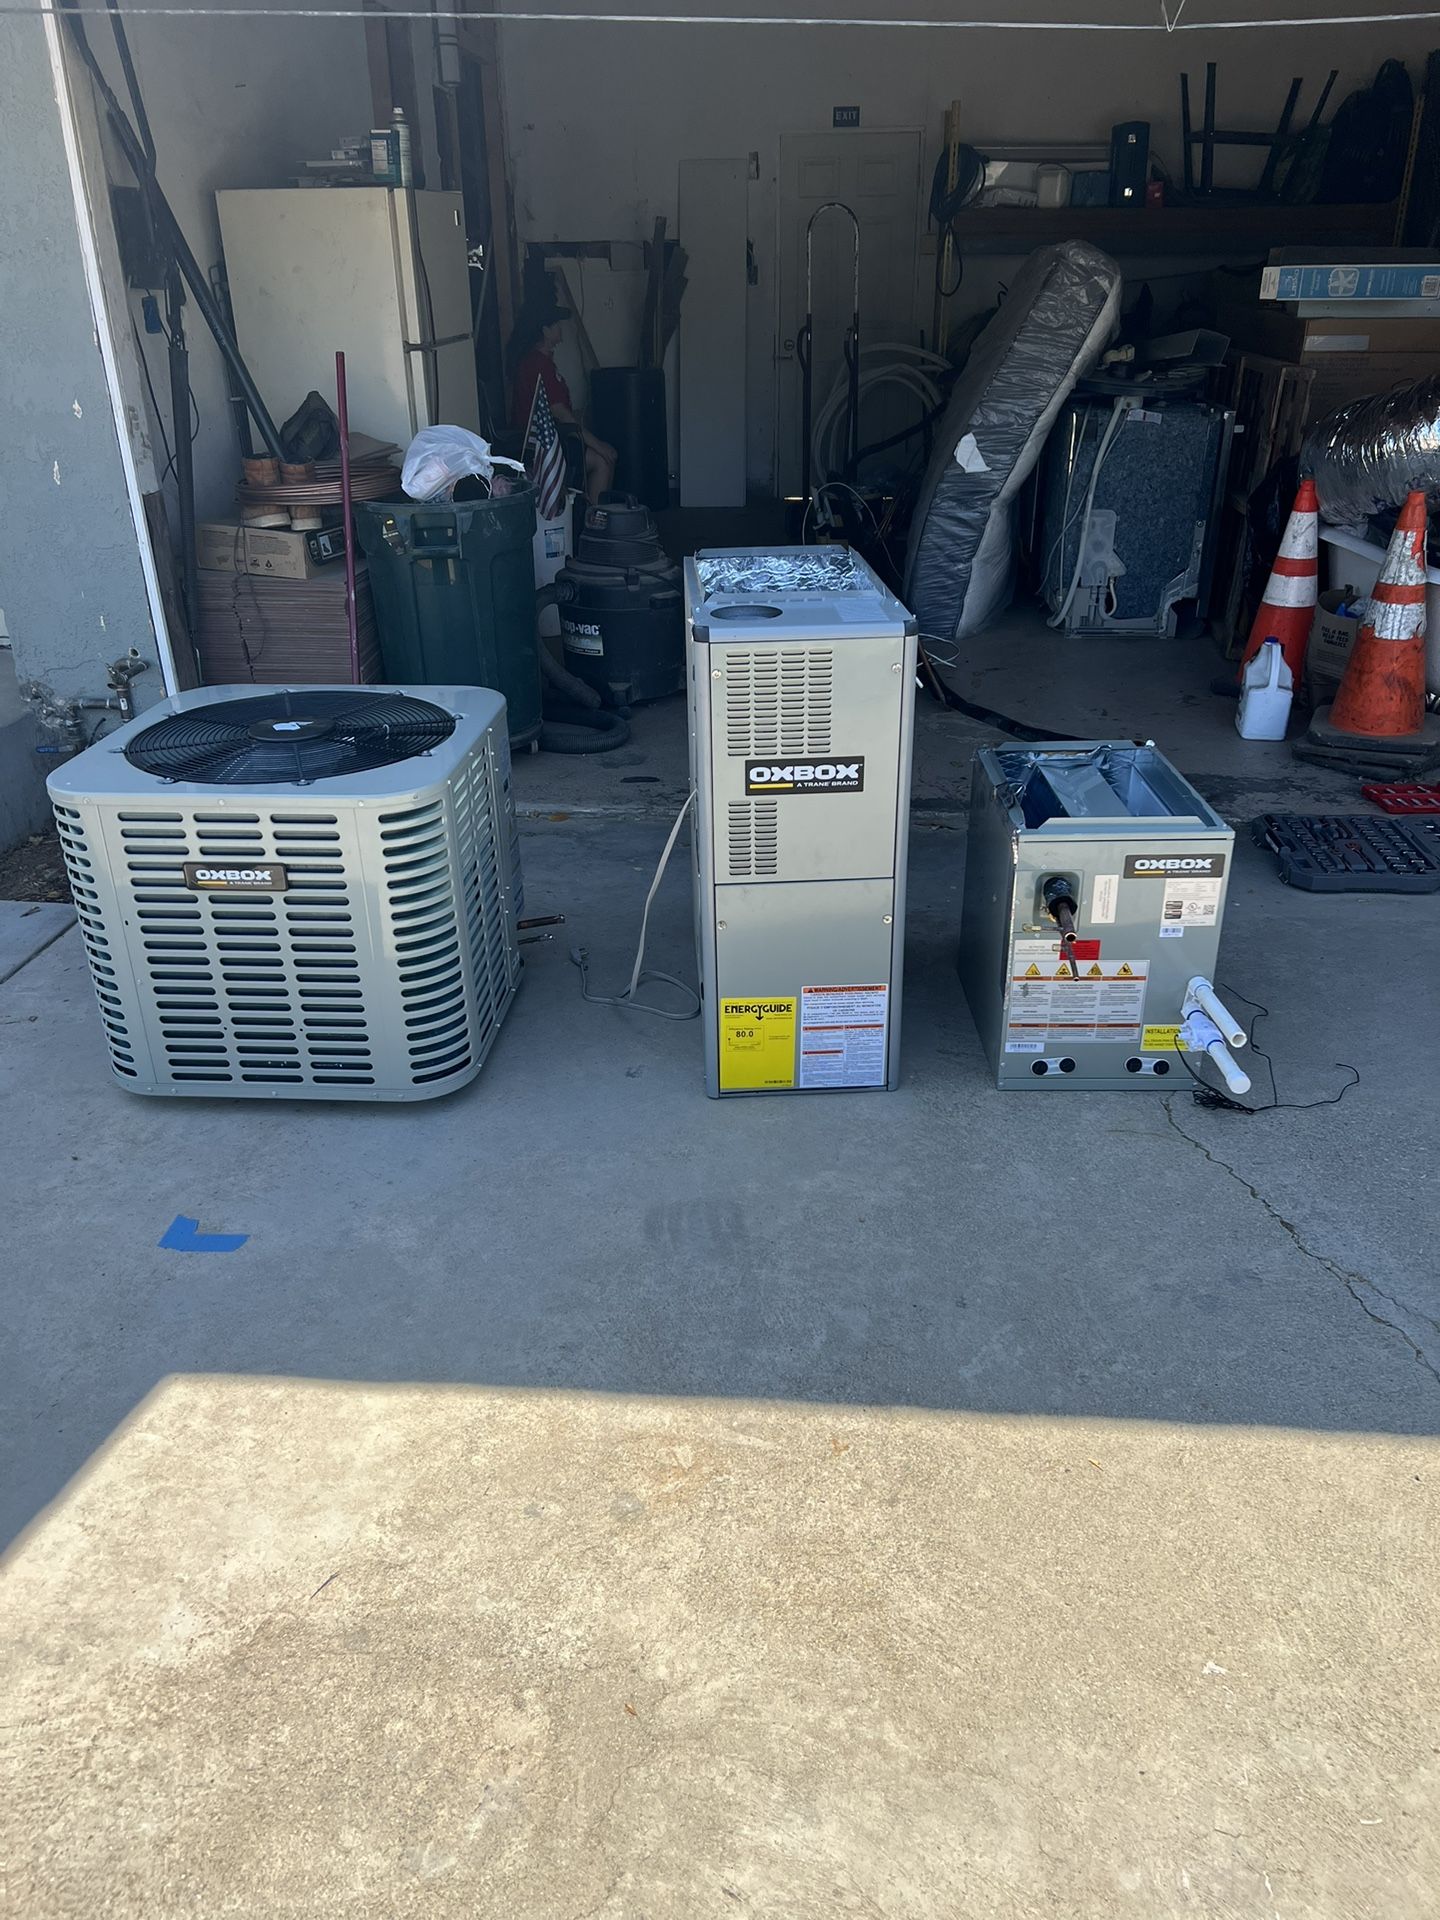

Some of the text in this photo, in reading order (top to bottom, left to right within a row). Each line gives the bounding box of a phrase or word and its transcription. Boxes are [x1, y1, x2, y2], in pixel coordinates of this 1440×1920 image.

[836, 111, 857, 120] EXIT
[749, 764, 860, 782] OXBOX
[1134, 858, 1213, 870] OXBOX
[195, 869, 272, 881] OXBOX
[725, 1004, 793, 1014] ENERGYGUIDE
[736, 1030, 754, 1038] 80.0
